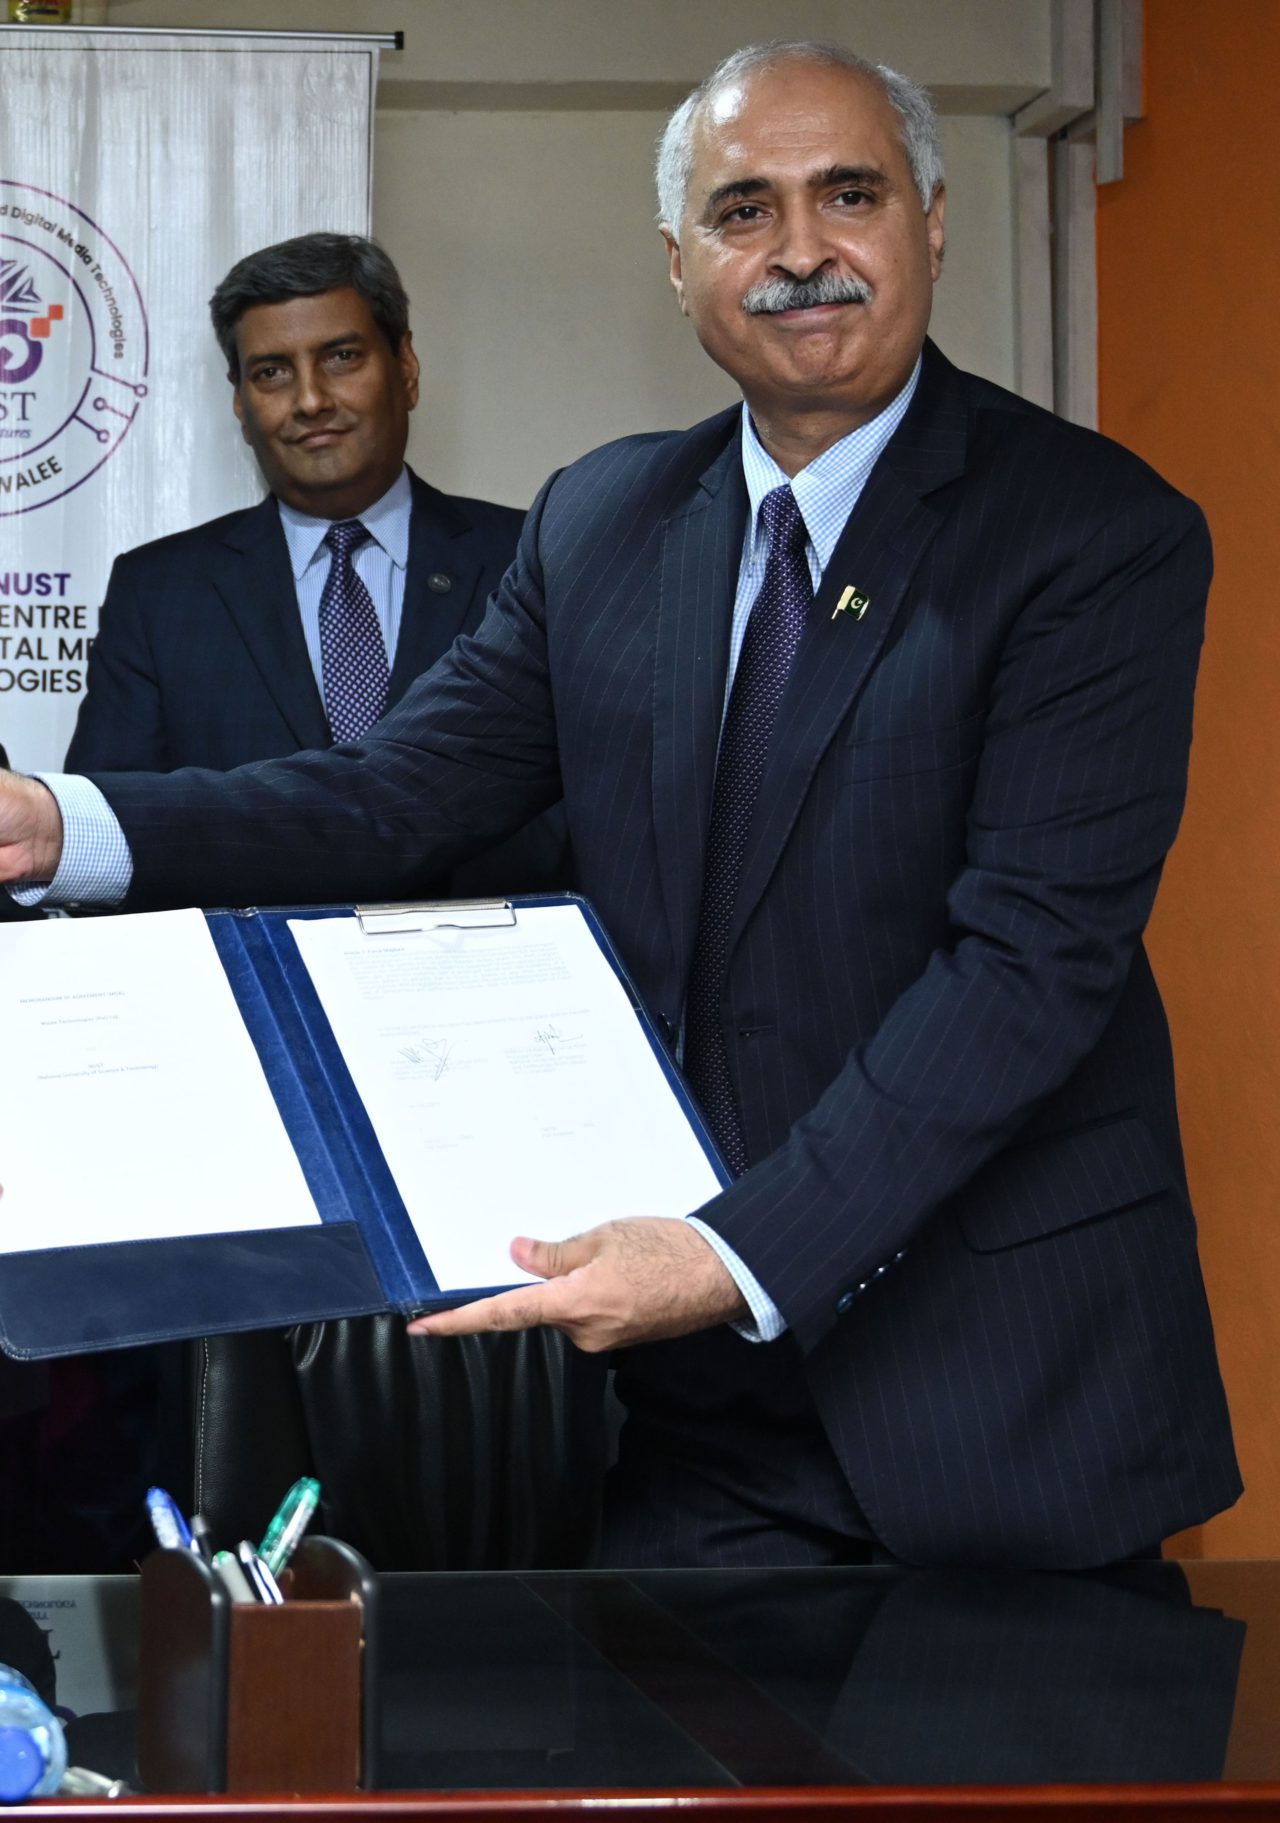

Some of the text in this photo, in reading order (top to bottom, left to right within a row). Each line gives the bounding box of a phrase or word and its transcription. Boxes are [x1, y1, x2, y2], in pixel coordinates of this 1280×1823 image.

[10, 206, 58, 234] Digital
[56, 227, 93, 267] Media
[90, 263, 127, 360] Technologies
